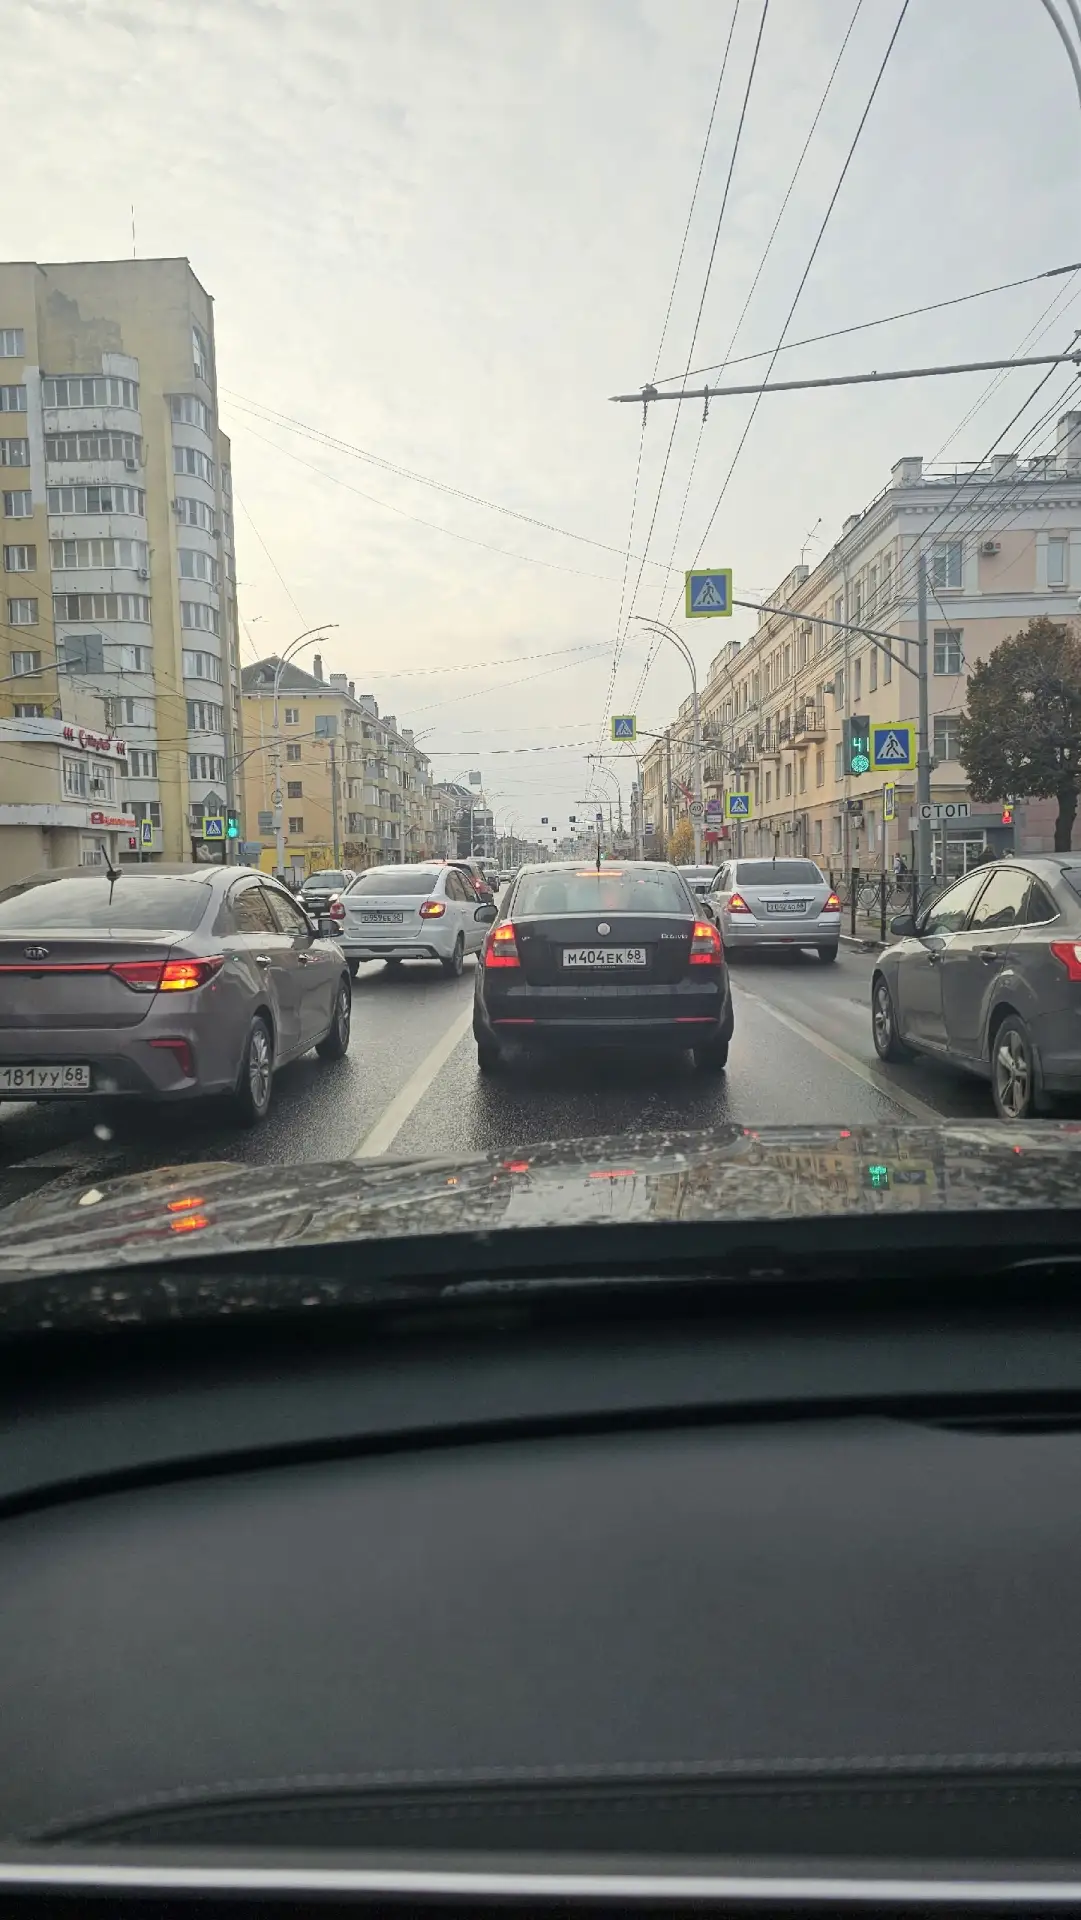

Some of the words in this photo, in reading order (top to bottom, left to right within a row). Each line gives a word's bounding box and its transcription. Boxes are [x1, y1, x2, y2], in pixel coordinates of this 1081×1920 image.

[921, 804, 968, 818] СТОП
[568, 950, 623, 964] М404ЕК
[627, 949, 641, 959] 68
[65, 1067, 83, 1081] 68
